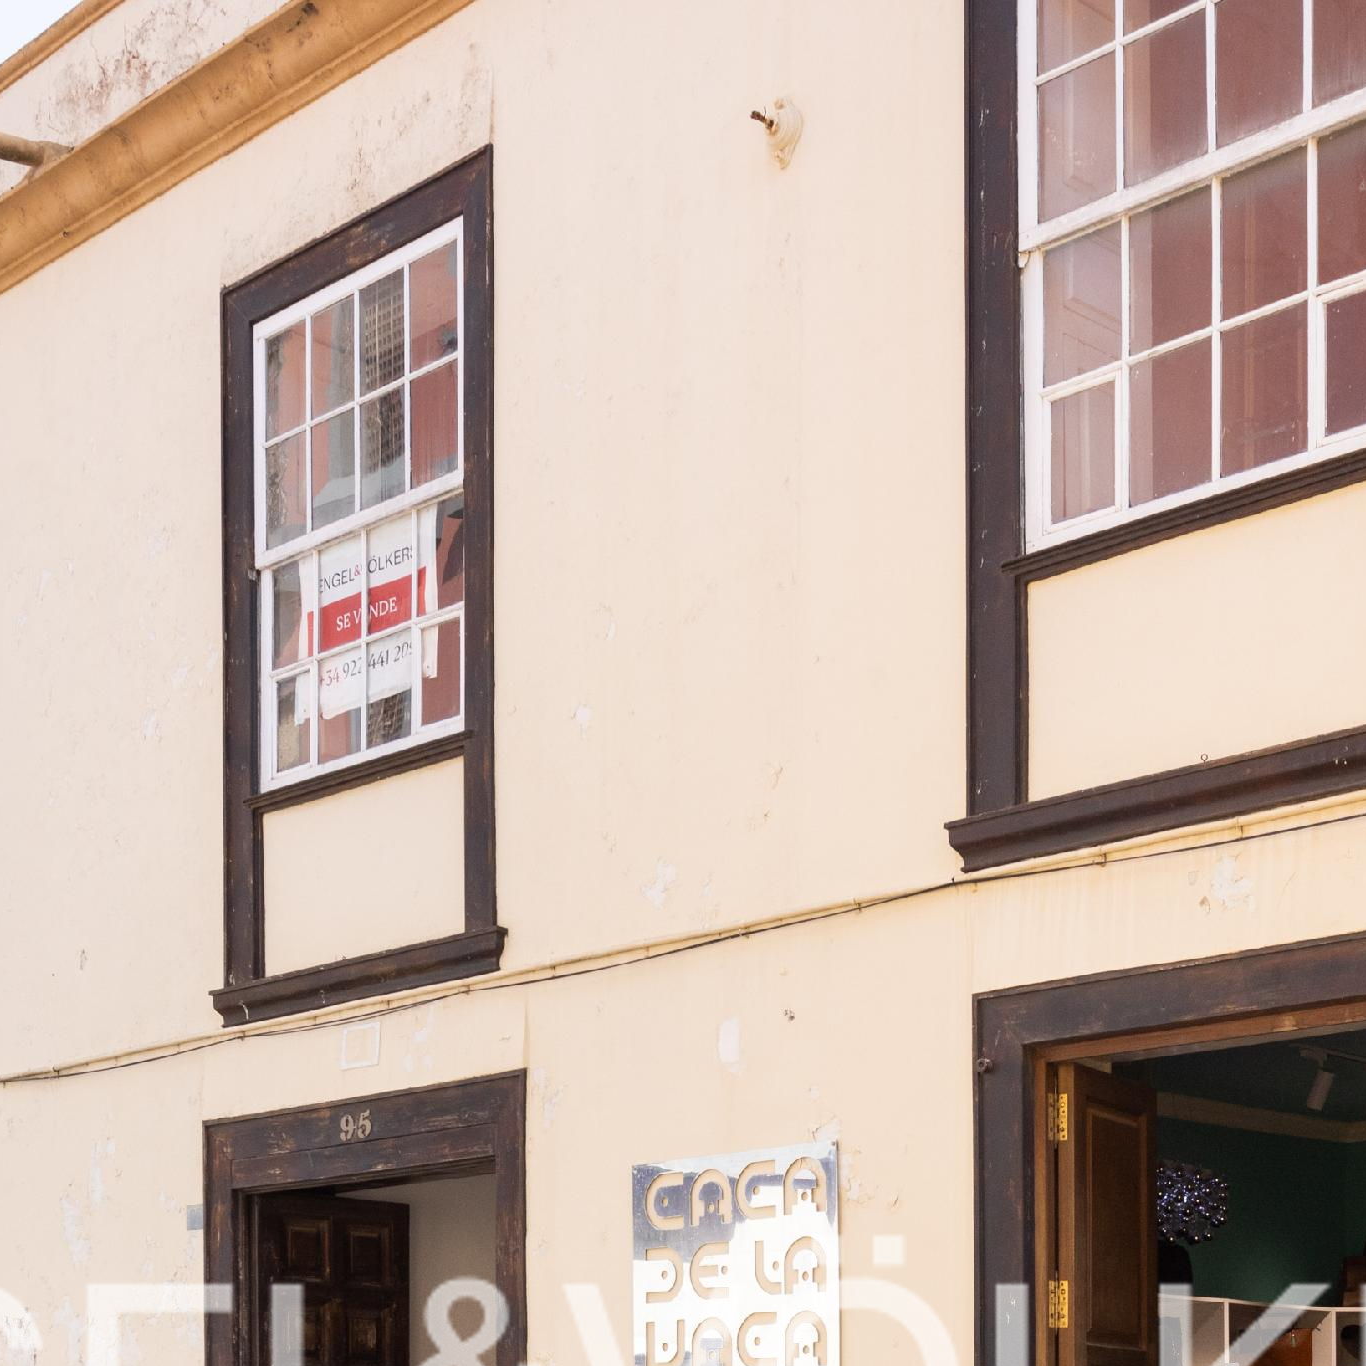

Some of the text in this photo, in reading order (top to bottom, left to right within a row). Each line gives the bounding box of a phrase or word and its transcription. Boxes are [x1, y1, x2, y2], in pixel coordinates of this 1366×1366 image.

[319, 546, 413, 594] ENGEL&ÖLKER
[336, 597, 398, 632] SE VNDE
[367, 649, 390, 670] 441
[339, 1109, 372, 1141] 95
[645, 1235, 828, 1304] DE LA
